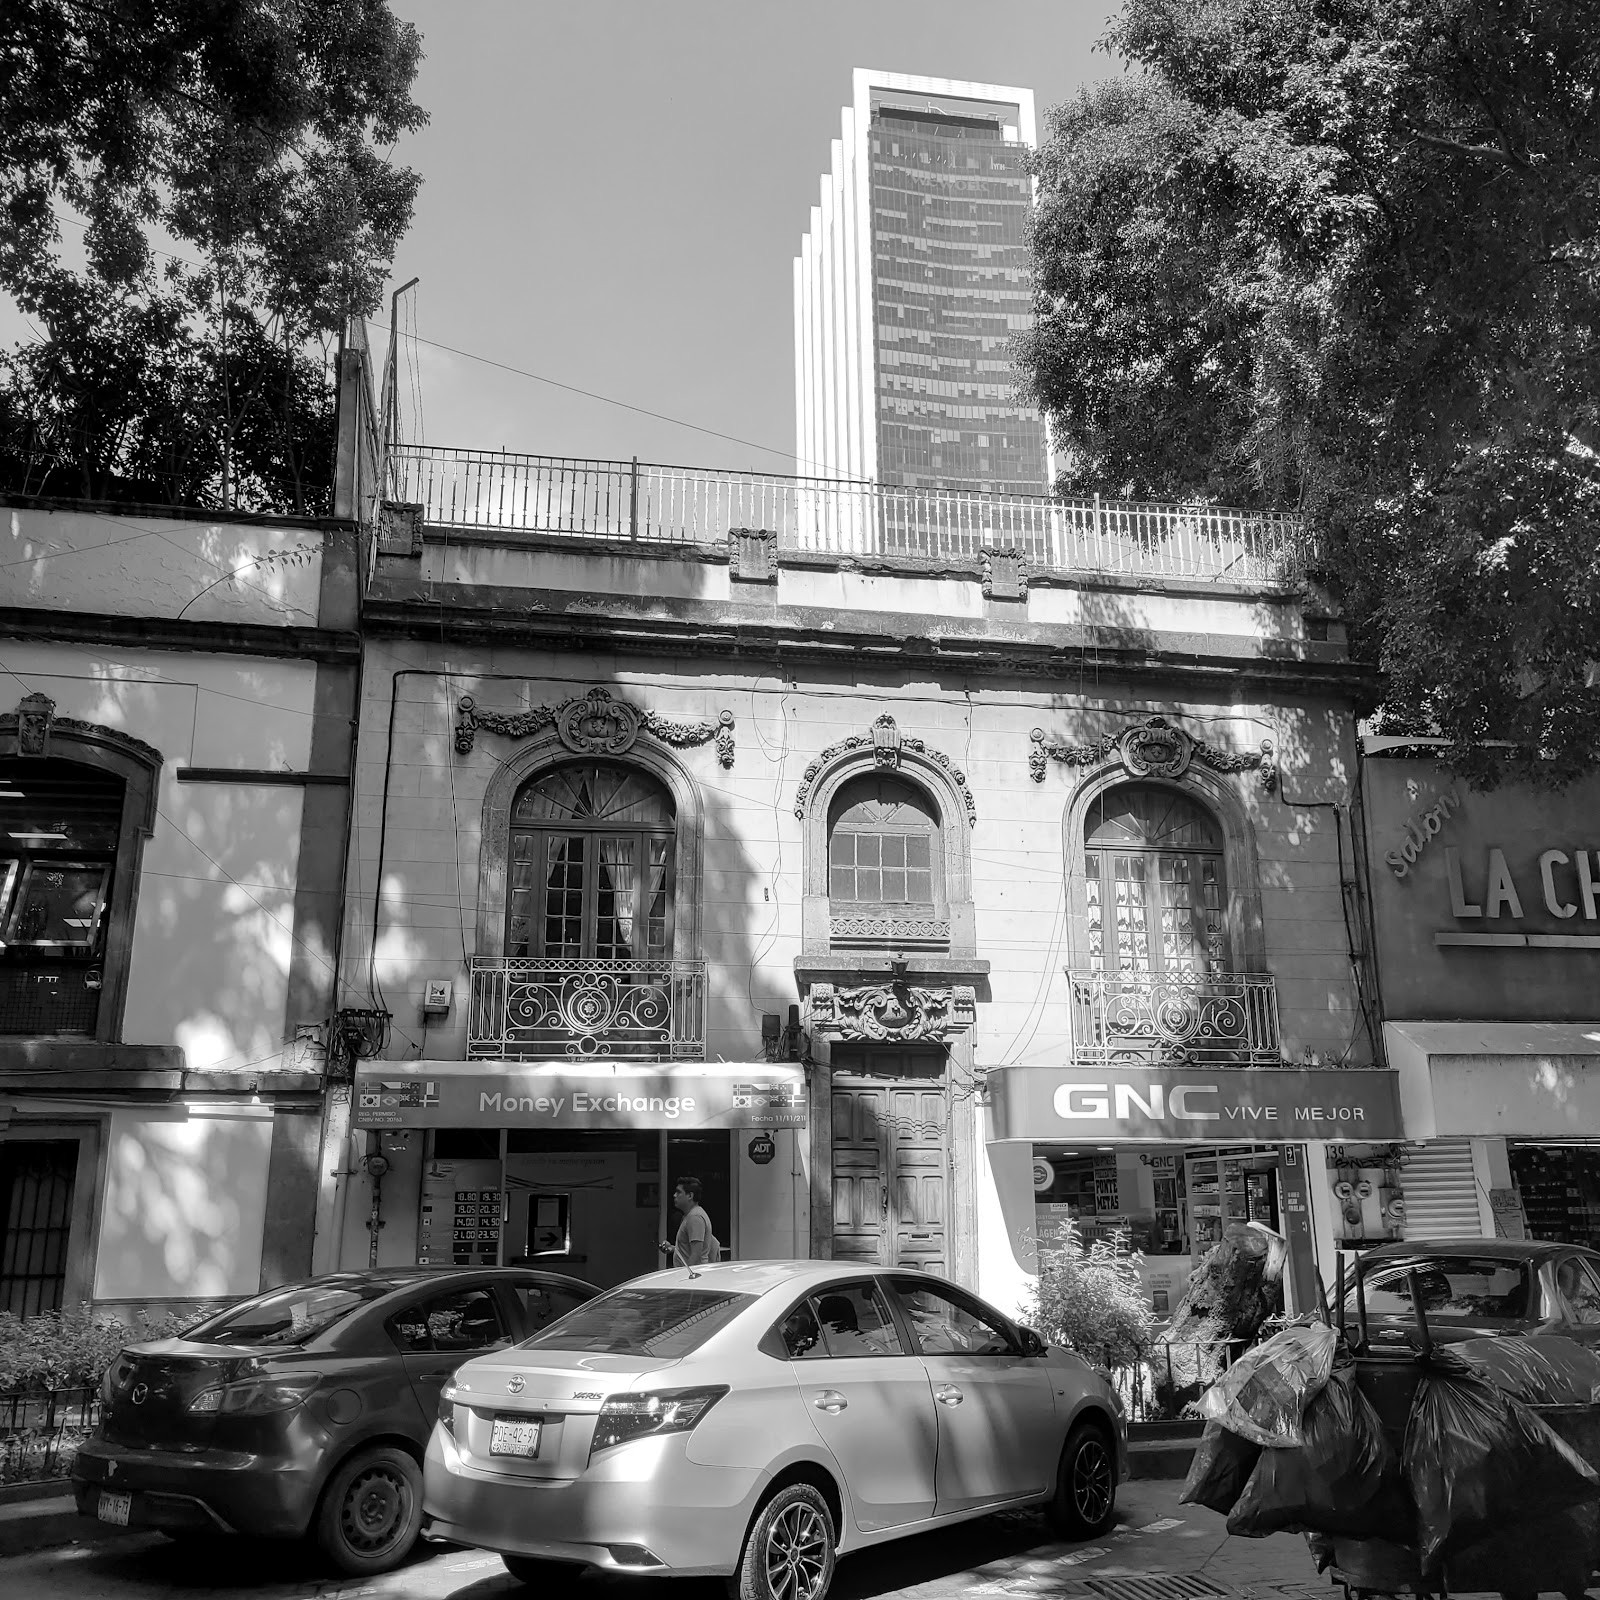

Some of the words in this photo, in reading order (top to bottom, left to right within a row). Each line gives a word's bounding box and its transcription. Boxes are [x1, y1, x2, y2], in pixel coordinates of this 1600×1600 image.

[1445, 847, 1525, 919] LA
[479, 1092, 565, 1117] Money
[572, 1092, 696, 1118] Exchange
[1052, 1083, 1220, 1120] GNC
[1224, 1106, 1278, 1120] VIVE
[1294, 1106, 1365, 1121] MEJOR
[753, 1143, 771, 1153] ADT
[1325, 1145, 1344, 1159] 139
[1152, 1155, 1174, 1168] GNC
[1095, 1178, 1118, 1194] PONTE
[1096, 1195, 1119, 1210] METAS
[453, 1230, 476, 1239] 21.00
[572, 1391, 604, 1400] YARIS
[492, 1425, 539, 1443] PDE-42-97
